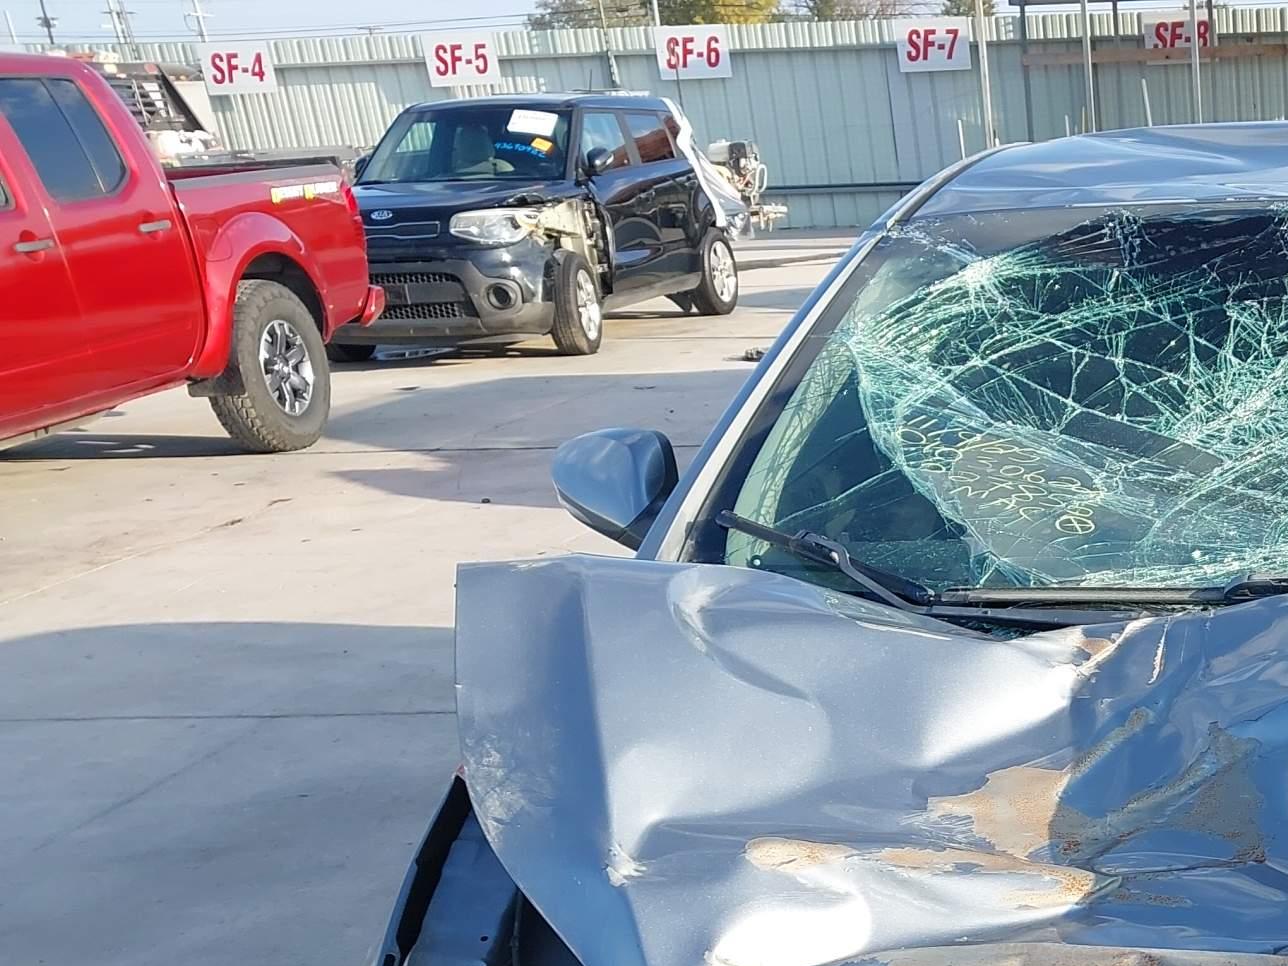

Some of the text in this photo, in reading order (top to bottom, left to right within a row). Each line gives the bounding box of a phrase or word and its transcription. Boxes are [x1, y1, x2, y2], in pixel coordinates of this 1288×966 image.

[434, 43, 488, 76] SF-5
[666, 36, 720, 69] SF-6
[906, 29, 959, 62] SF-7
[210, 52, 265, 84] SF-4
